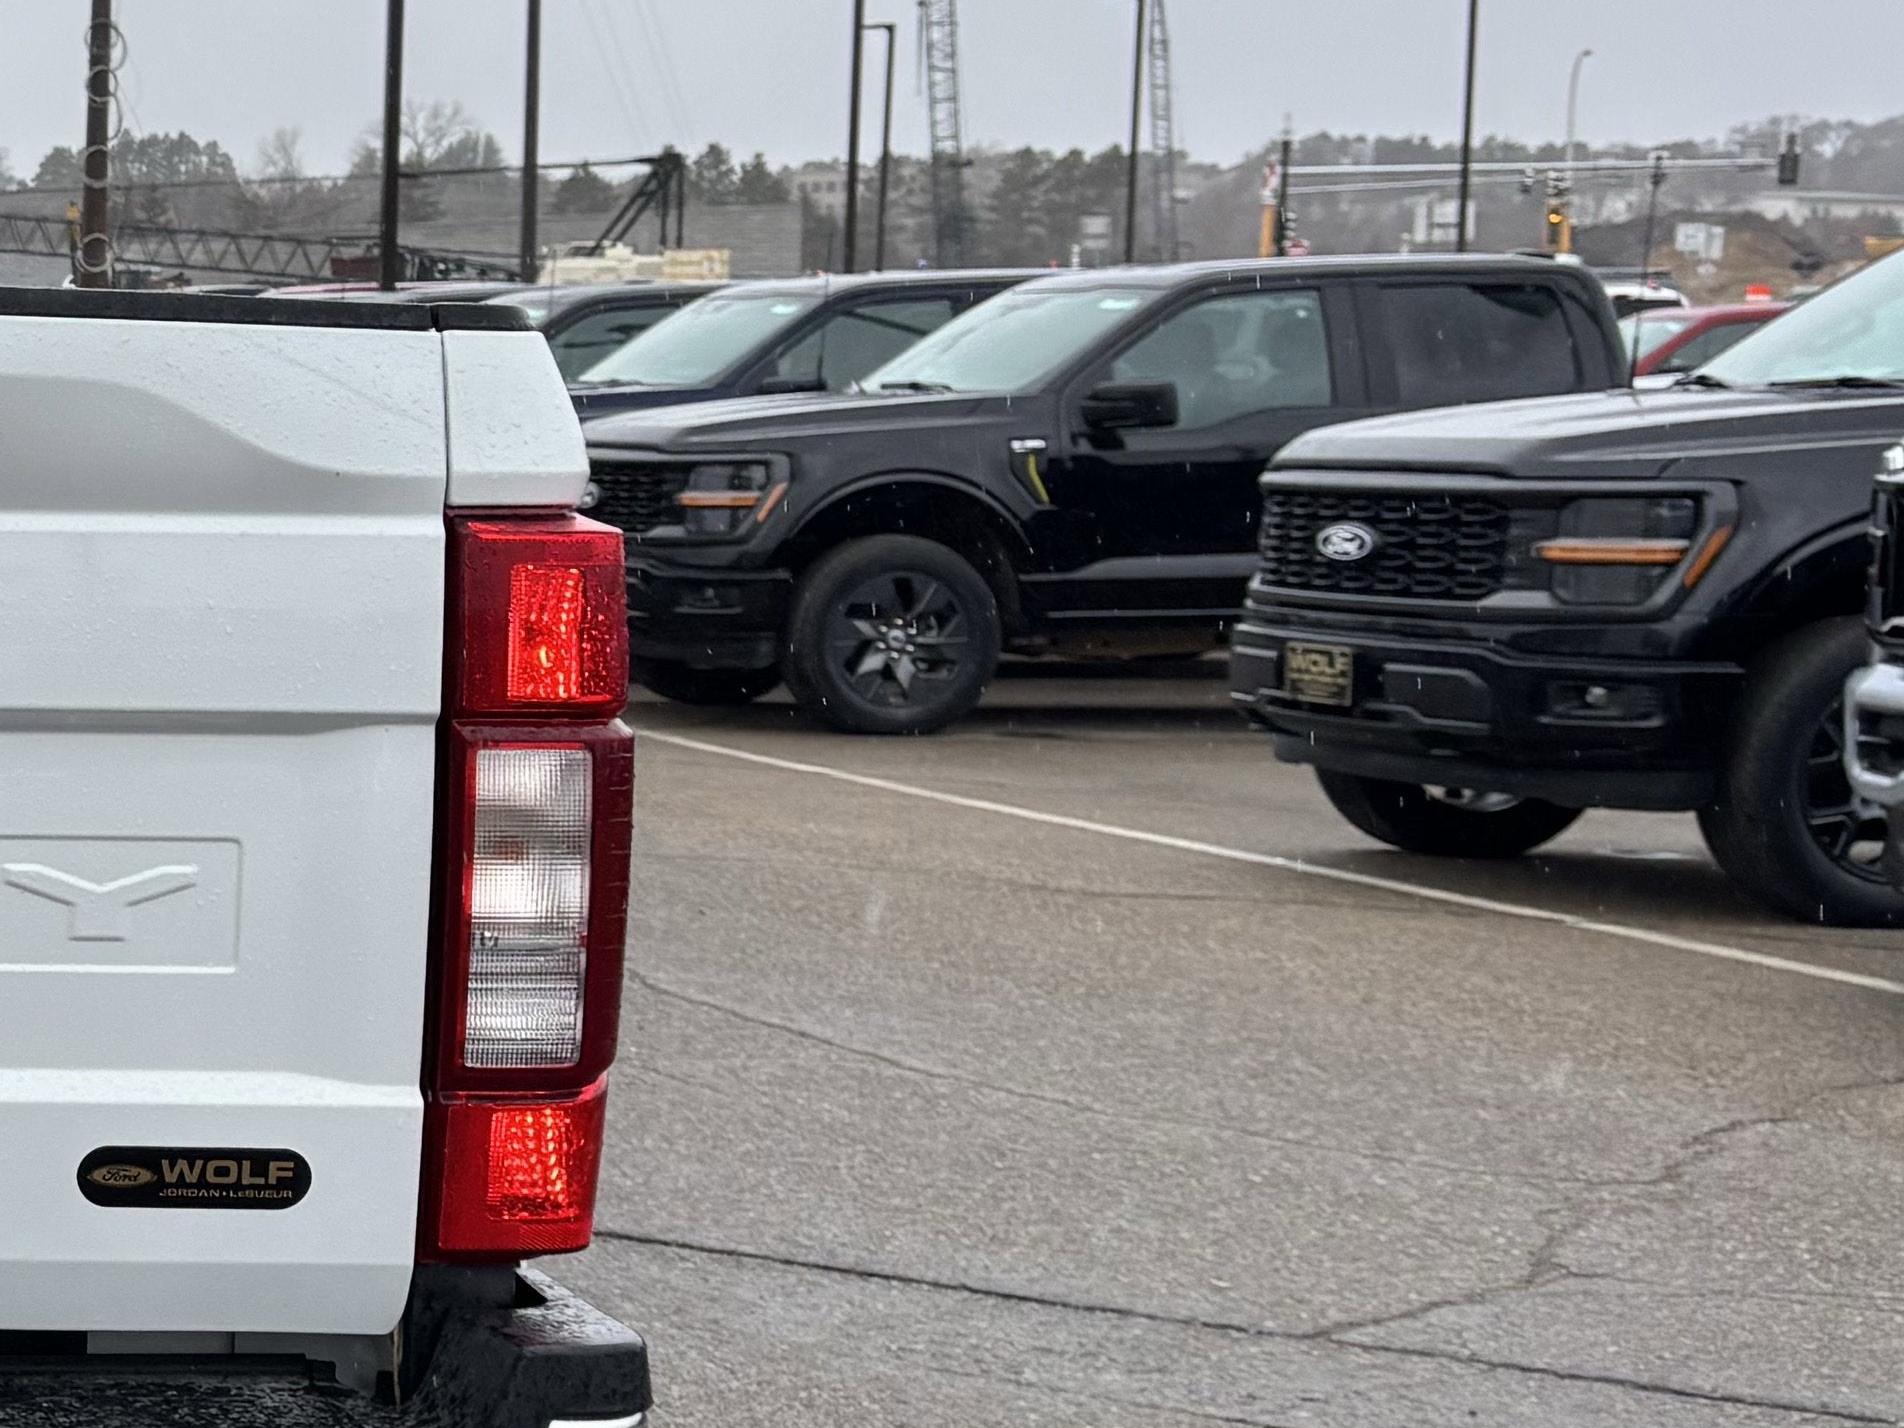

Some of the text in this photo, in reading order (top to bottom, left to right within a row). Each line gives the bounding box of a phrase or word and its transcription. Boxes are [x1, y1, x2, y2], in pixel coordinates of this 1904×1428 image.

[101, 1158, 295, 1185] Ford WOLF
[159, 1188, 220, 1198] JORDAN
